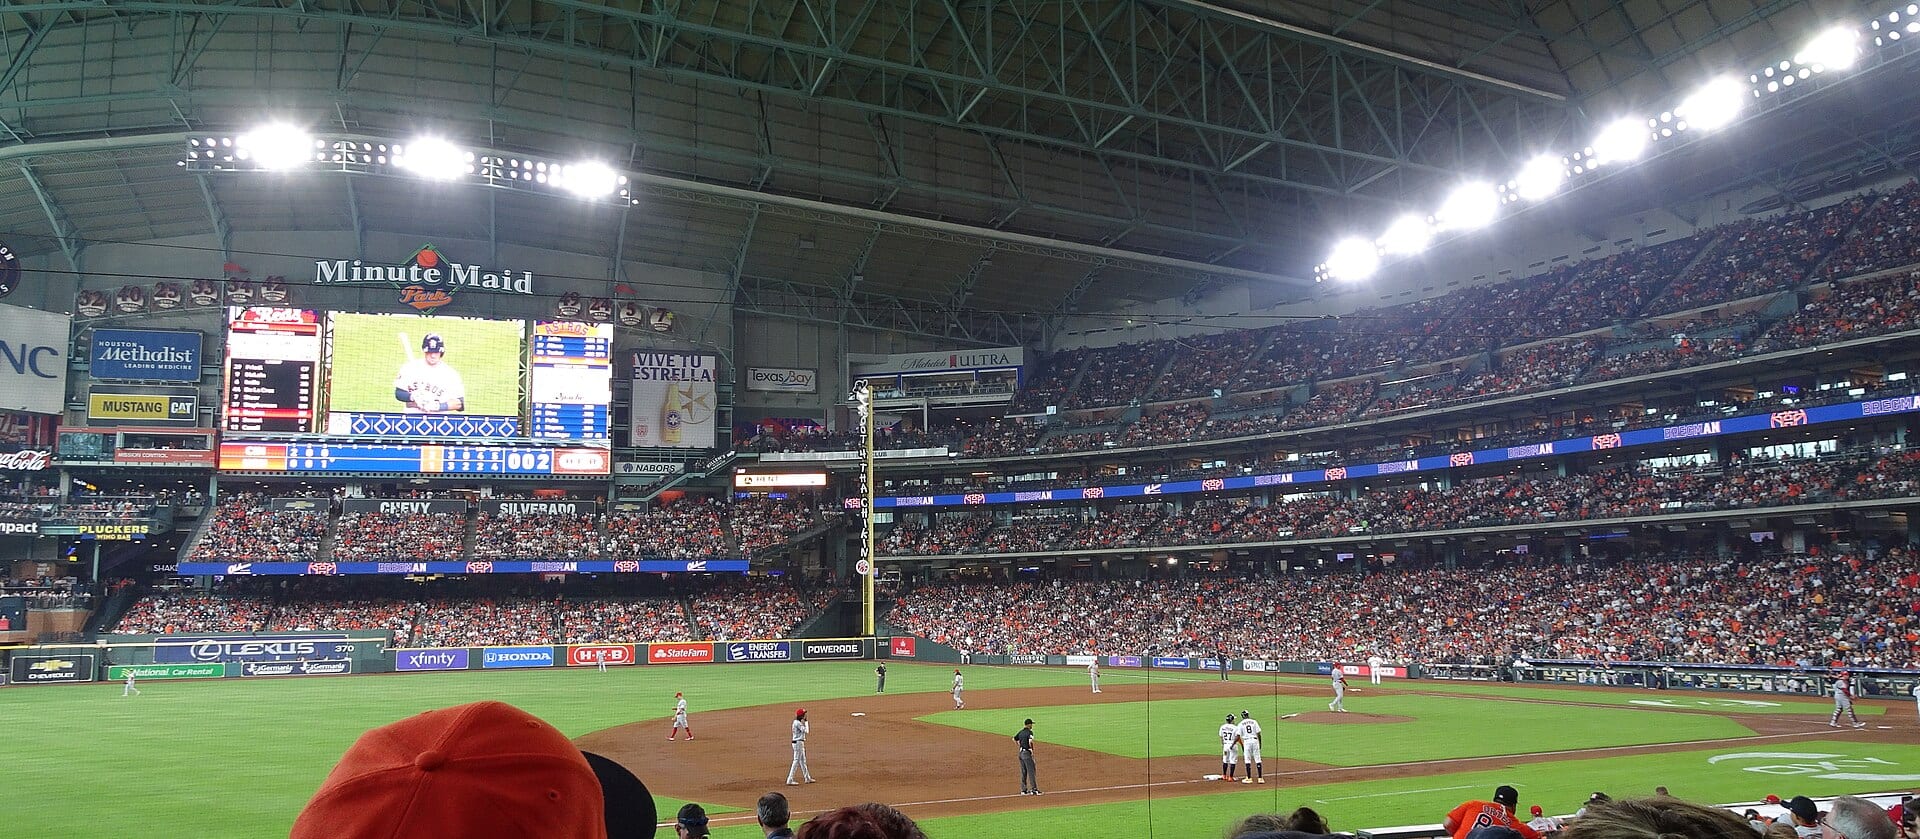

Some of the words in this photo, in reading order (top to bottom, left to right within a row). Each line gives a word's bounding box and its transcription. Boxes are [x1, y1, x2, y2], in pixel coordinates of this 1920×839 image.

[314, 260, 441, 283] Minute
[448, 262, 534, 294] Maid
[117, 285, 144, 301] 40
[400, 285, 452, 305] Park
[626, 302, 636, 316] 5
[656, 307, 668, 323] 7
[98, 345, 193, 363] Methodist
[959, 353, 1010, 367] ULTRA
[680, 354, 702, 369] TU
[750, 369, 784, 383] Texas
[784, 371, 813, 387] Bay
[103, 401, 163, 412] MUSTANG
[171, 402, 194, 414] CAT
[1664, 421, 1721, 440] BREGMAN
[635, 463, 676, 473] NABORS
[859, 463, 868, 494] THA
[380, 501, 430, 514] CHEVY
[500, 503, 576, 515] SILVERADO
[79, 525, 149, 534] PLUCKERS
[860, 496, 868, 559] CHIKIN
[225, 643, 315, 656] LEXUS
[335, 645, 354, 653] 370
[749, 642, 778, 652] ENERGY
[807, 643, 858, 655] POWERADE
[409, 651, 456, 668] xfinity
[498, 653, 551, 662] HONDA
[749, 650, 787, 660] TRANSFER
[133, 668, 169, 677] National
[187, 668, 213, 676] Rental
[1223, 732, 1233, 741] 27
[1246, 725, 1253, 734] 8
